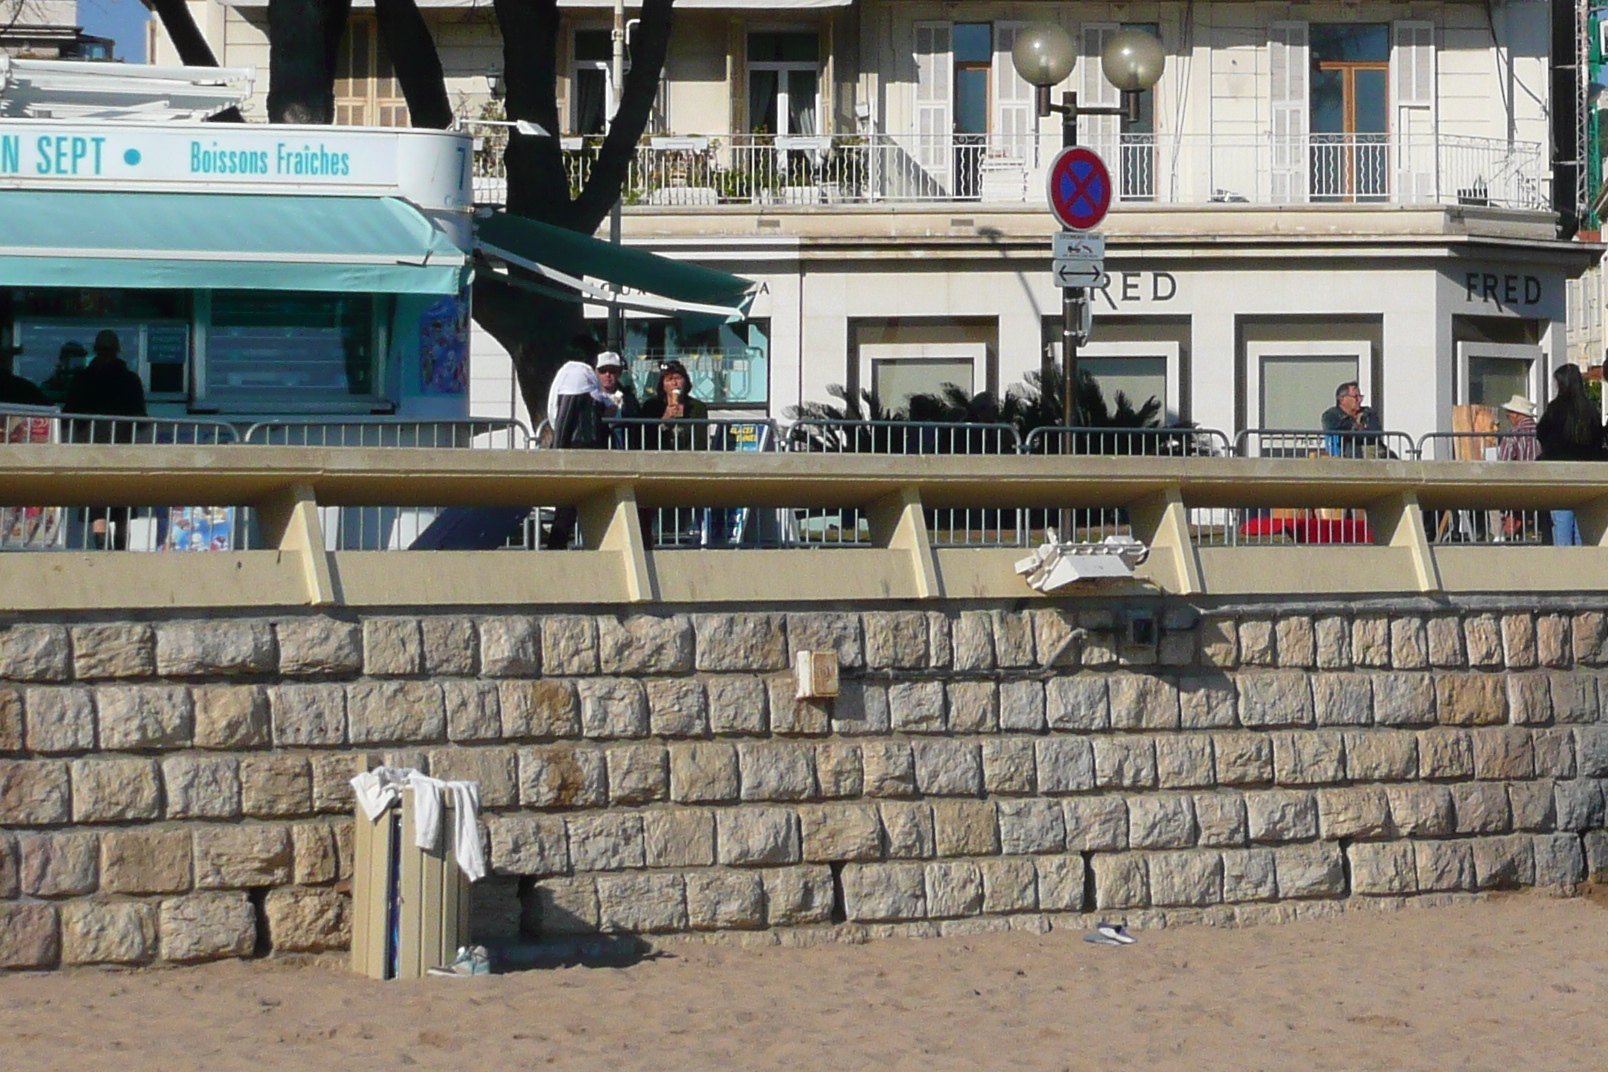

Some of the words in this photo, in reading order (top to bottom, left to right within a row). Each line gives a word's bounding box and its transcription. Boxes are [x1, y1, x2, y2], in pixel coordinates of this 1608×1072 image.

[36, 135, 106, 175] SEPT
[190, 141, 267, 174] Boissons
[277, 143, 350, 175] Fraîches
[1090, 272, 1177, 310] RED
[1466, 273, 1541, 312] FRED
